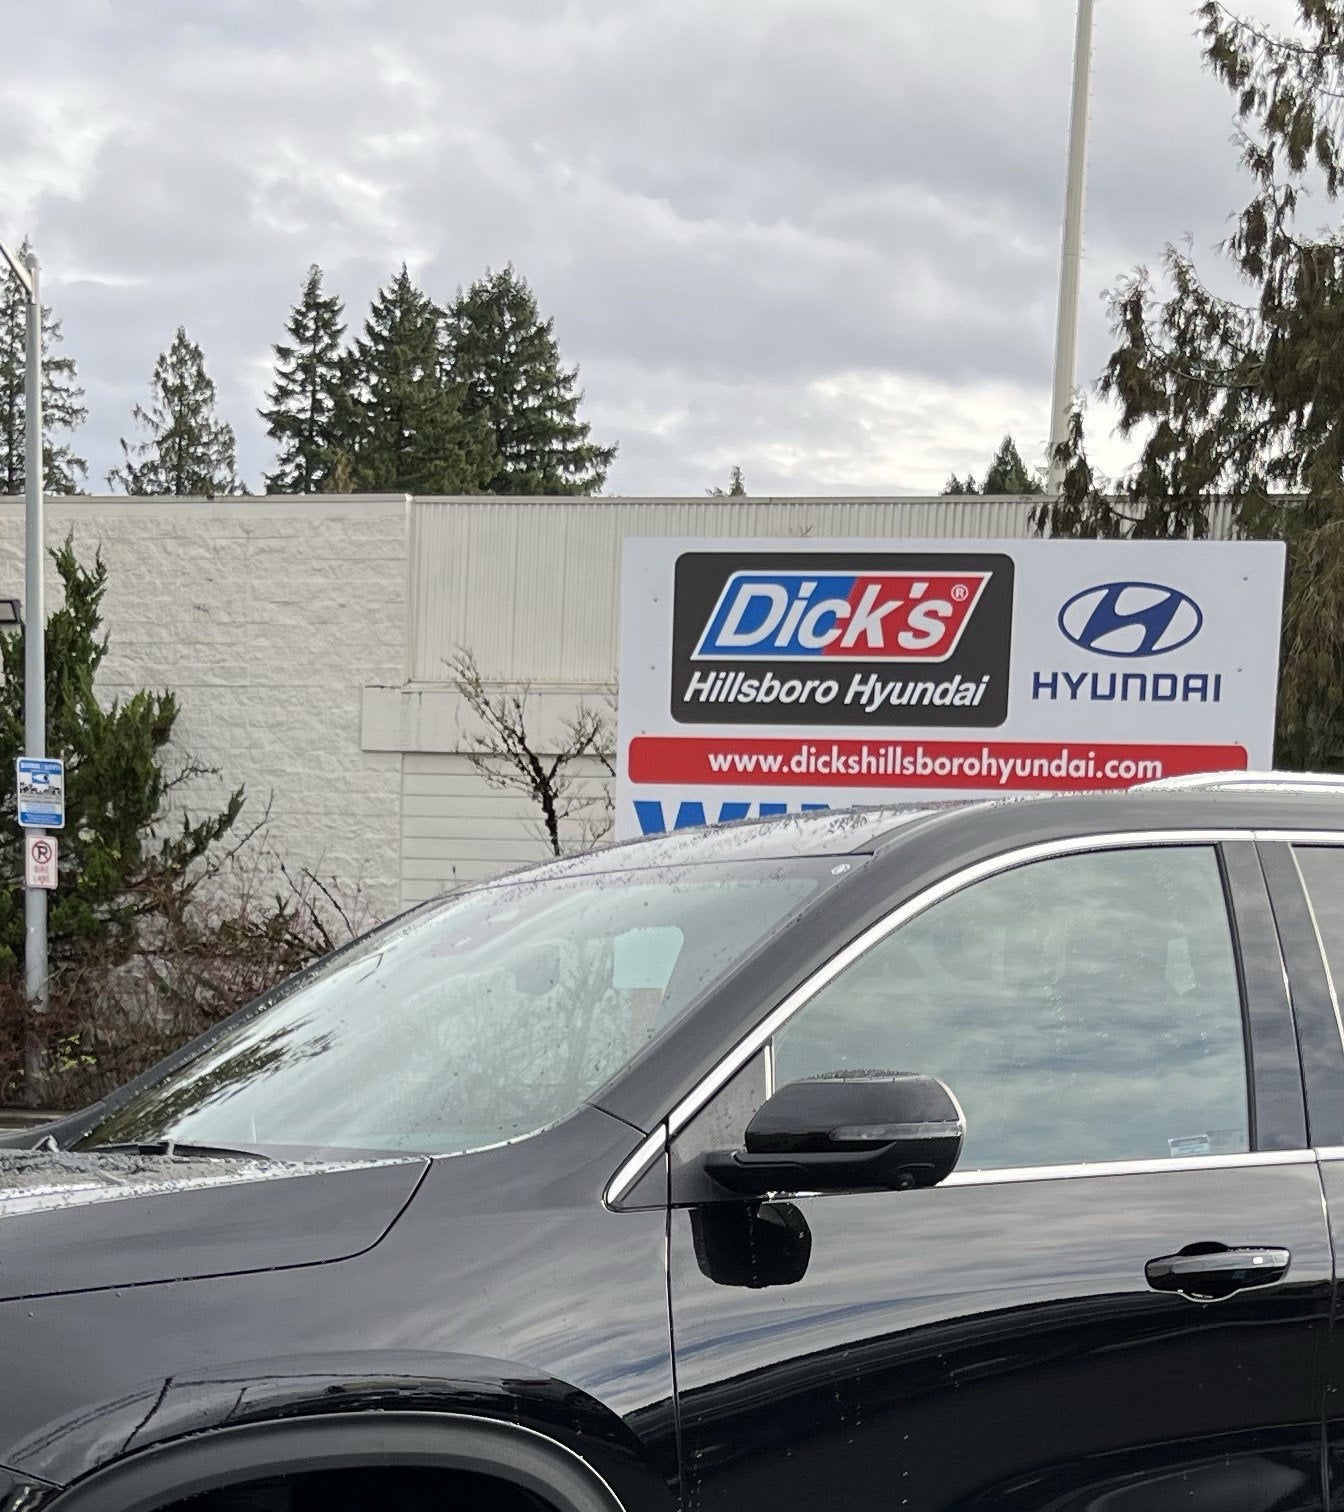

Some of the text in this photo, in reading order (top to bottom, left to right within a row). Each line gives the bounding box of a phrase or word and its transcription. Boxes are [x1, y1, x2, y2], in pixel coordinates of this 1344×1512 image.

[716, 582, 953, 649] Dick's
[684, 671, 991, 713] Hillsboro Hyundai
[1033, 671, 1222, 702] HYUNDAI
[708, 744, 1164, 784] www.dickshillsborohyundai.com
